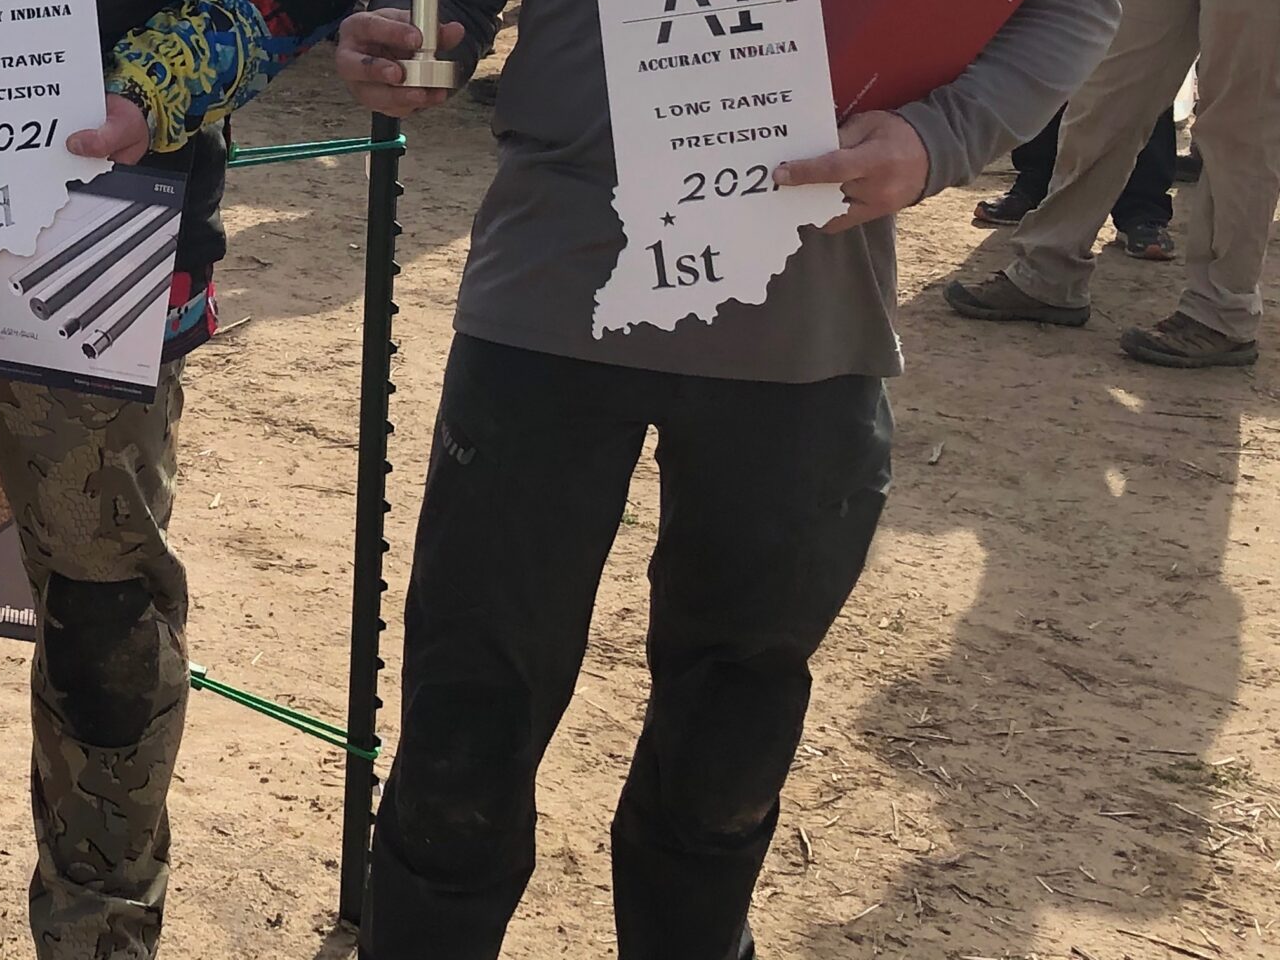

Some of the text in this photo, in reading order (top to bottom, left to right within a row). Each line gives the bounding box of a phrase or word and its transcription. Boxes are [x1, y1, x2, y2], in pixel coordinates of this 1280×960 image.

[10, 4, 72, 21] INDIANA
[0, 50, 66, 69] RANGE
[637, 40, 799, 73] ACCURACY INDIANA
[654, 89, 793, 119] LONG RANGE
[670, 124, 788, 151] PRECISION
[153, 183, 175, 194] STEEL
[645, 239, 724, 291] 1st
